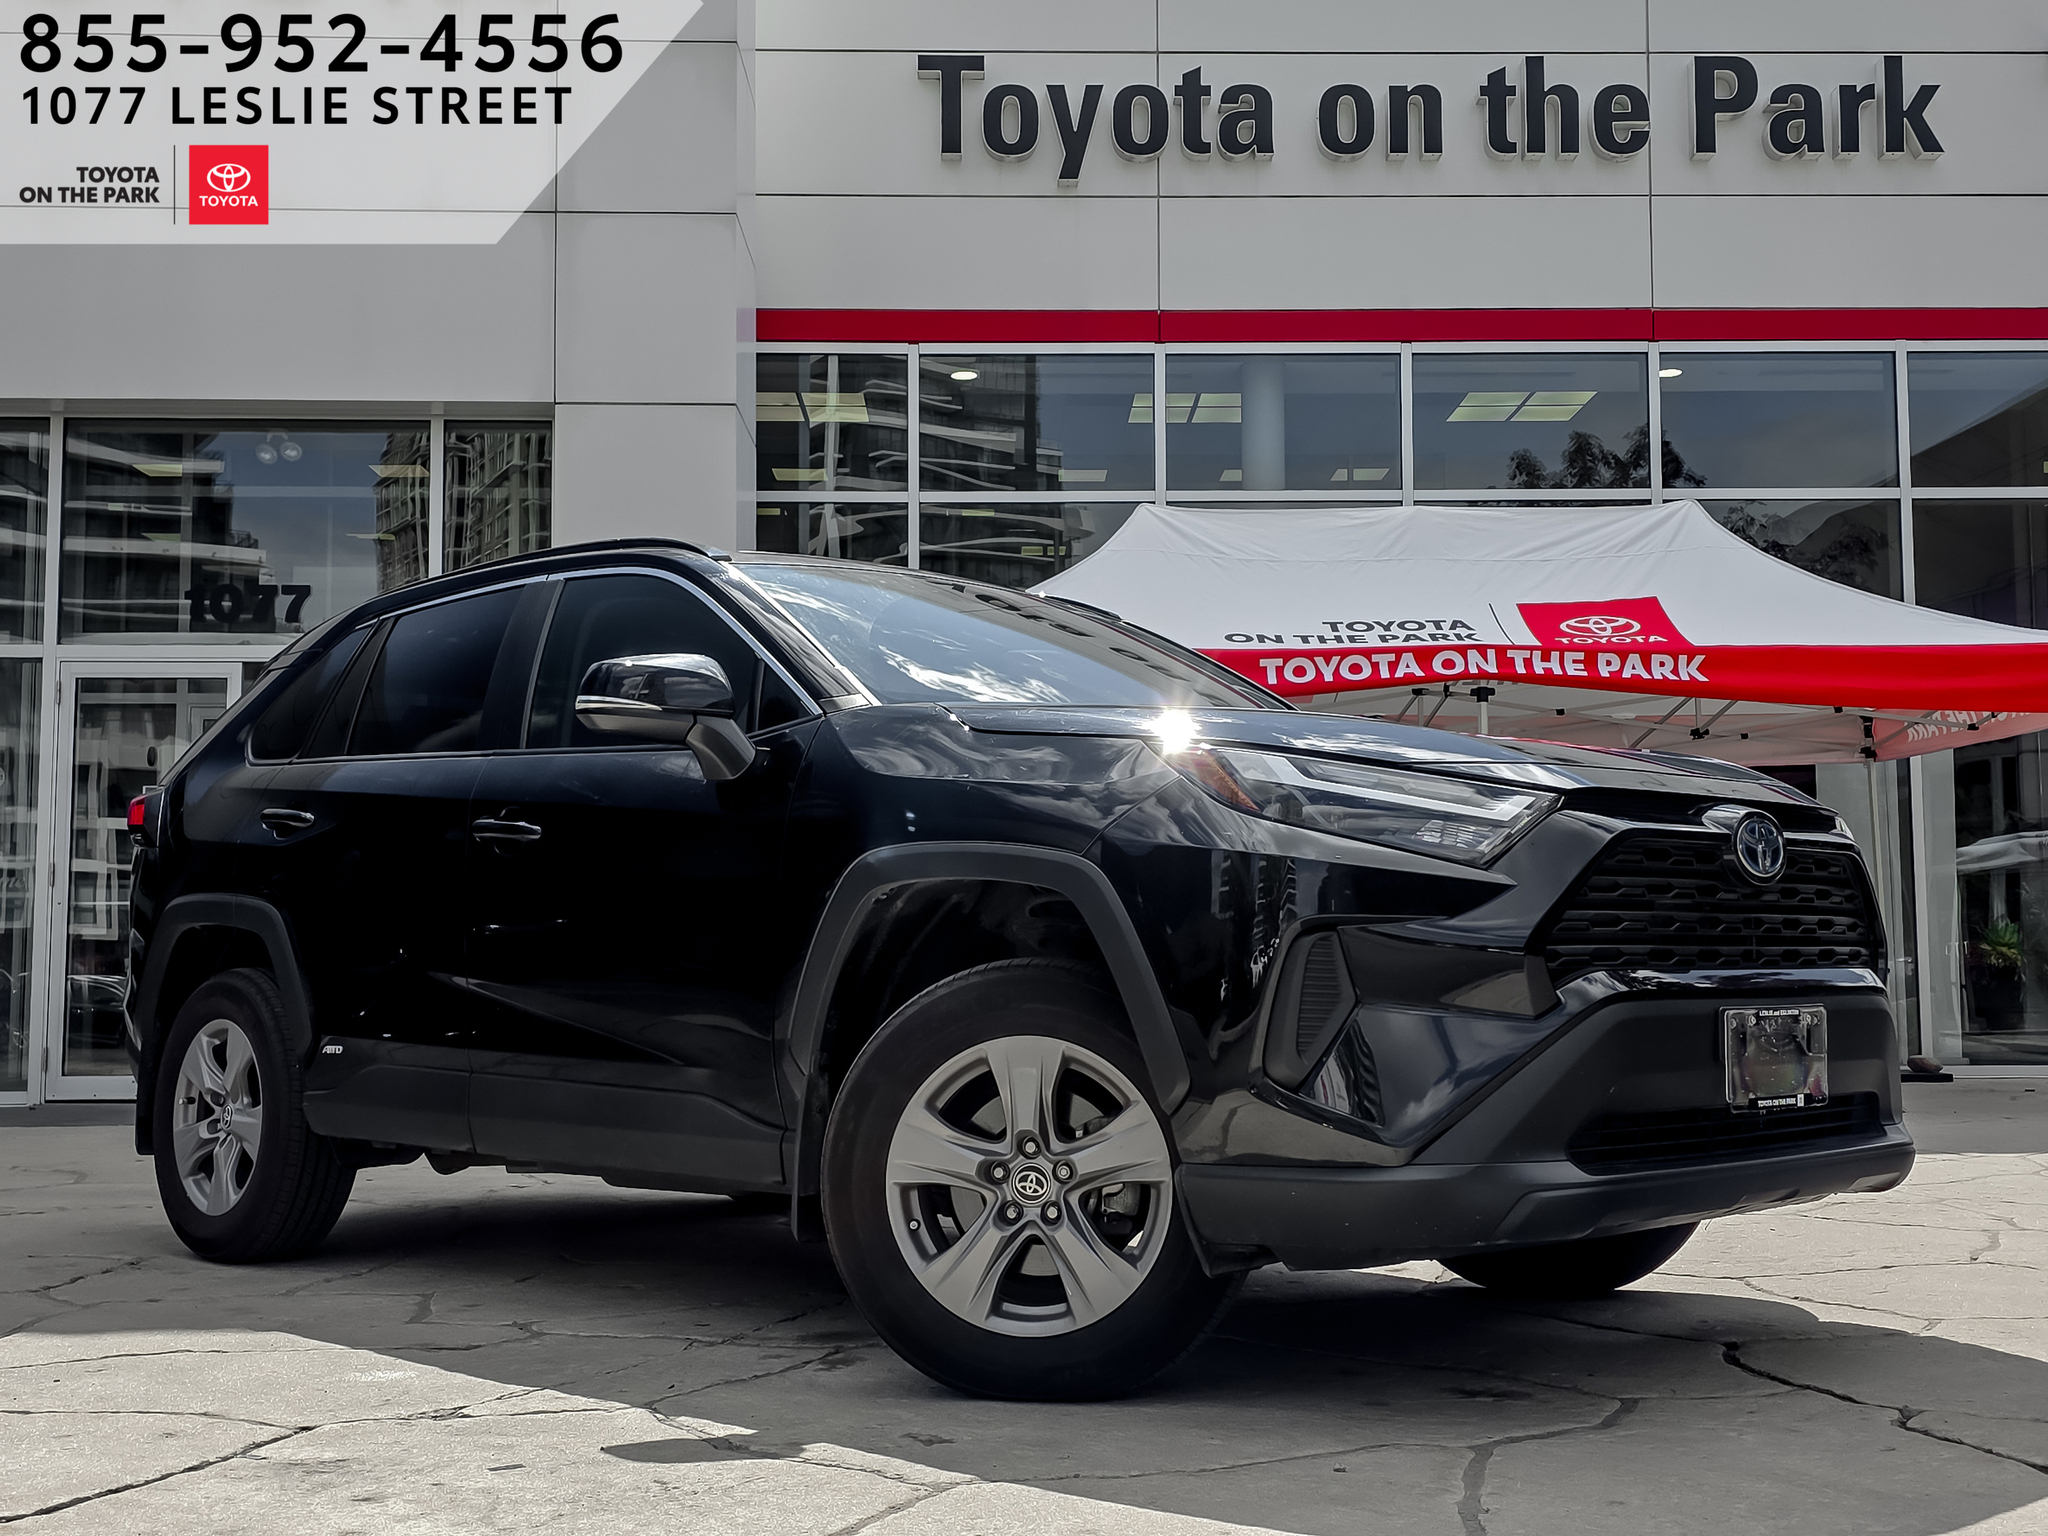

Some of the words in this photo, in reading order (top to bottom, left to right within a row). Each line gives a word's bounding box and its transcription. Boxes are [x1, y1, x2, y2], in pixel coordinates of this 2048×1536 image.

[917, 54, 1275, 187] Toyota
[1317, 82, 1444, 162] on
[1476, 55, 1651, 163] the
[1688, 54, 1945, 162] Park
[184, 583, 311, 624] 1077
[1223, 633, 1285, 644] ON
[1292, 634, 1369, 645] THE
[1377, 632, 1484, 644] PARK
[1321, 619, 1477, 633] TOYOTA
[1554, 635, 1669, 644] TOYOTA
[1259, 652, 1425, 685] TOYOTA
[1432, 649, 1498, 675] ON
[1507, 649, 1588, 676] THE
[1598, 652, 1710, 682] PARK
